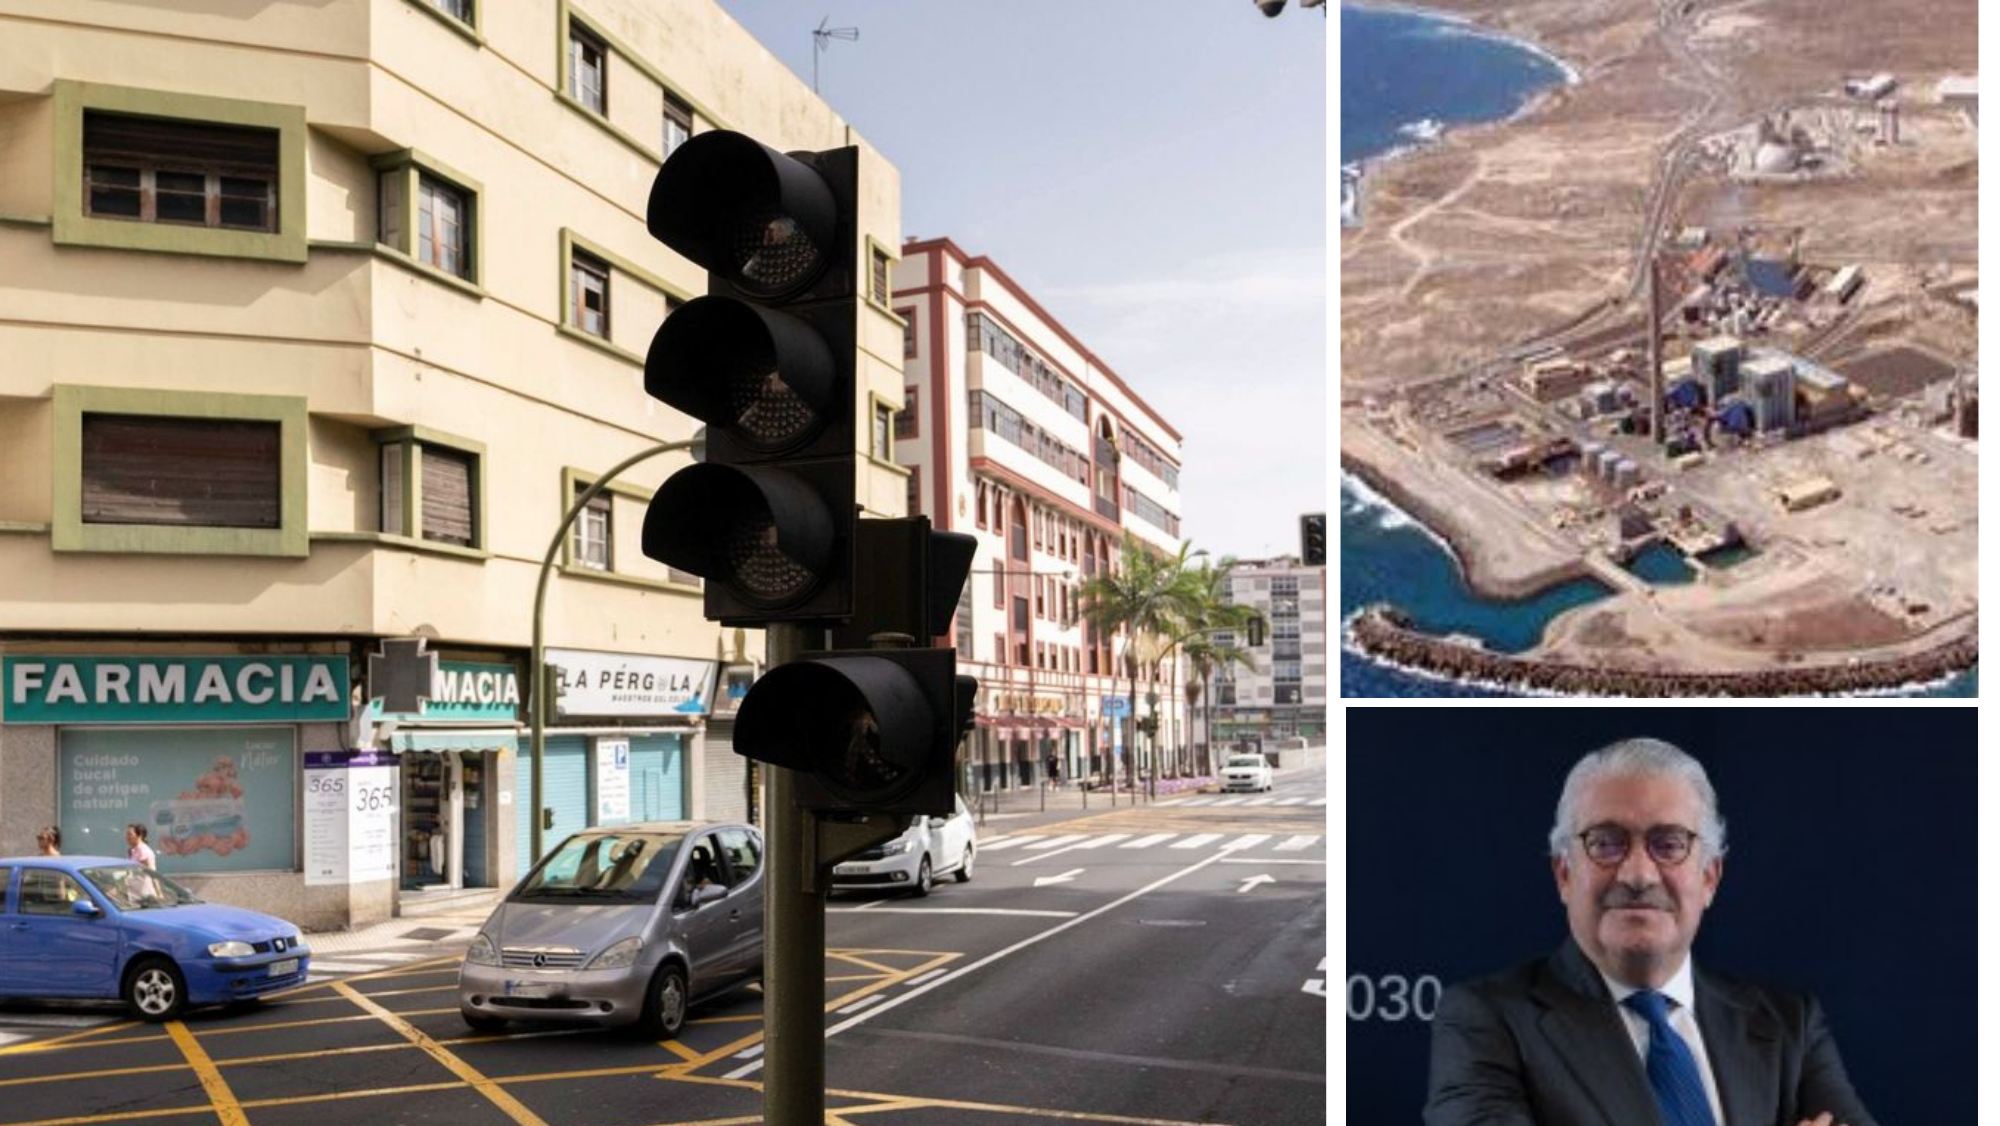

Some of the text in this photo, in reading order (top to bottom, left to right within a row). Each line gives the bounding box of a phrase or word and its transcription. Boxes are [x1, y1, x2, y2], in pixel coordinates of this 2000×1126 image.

[13, 662, 339, 704] FARMACIA
[562, 669, 587, 688] LA
[431, 670, 520, 704] MACIA
[73, 754, 140, 767] Cuidado
[73, 768, 116, 780] bucal
[73, 781, 150, 797] de origen
[309, 778, 345, 793] 365
[73, 797, 128, 810] natural
